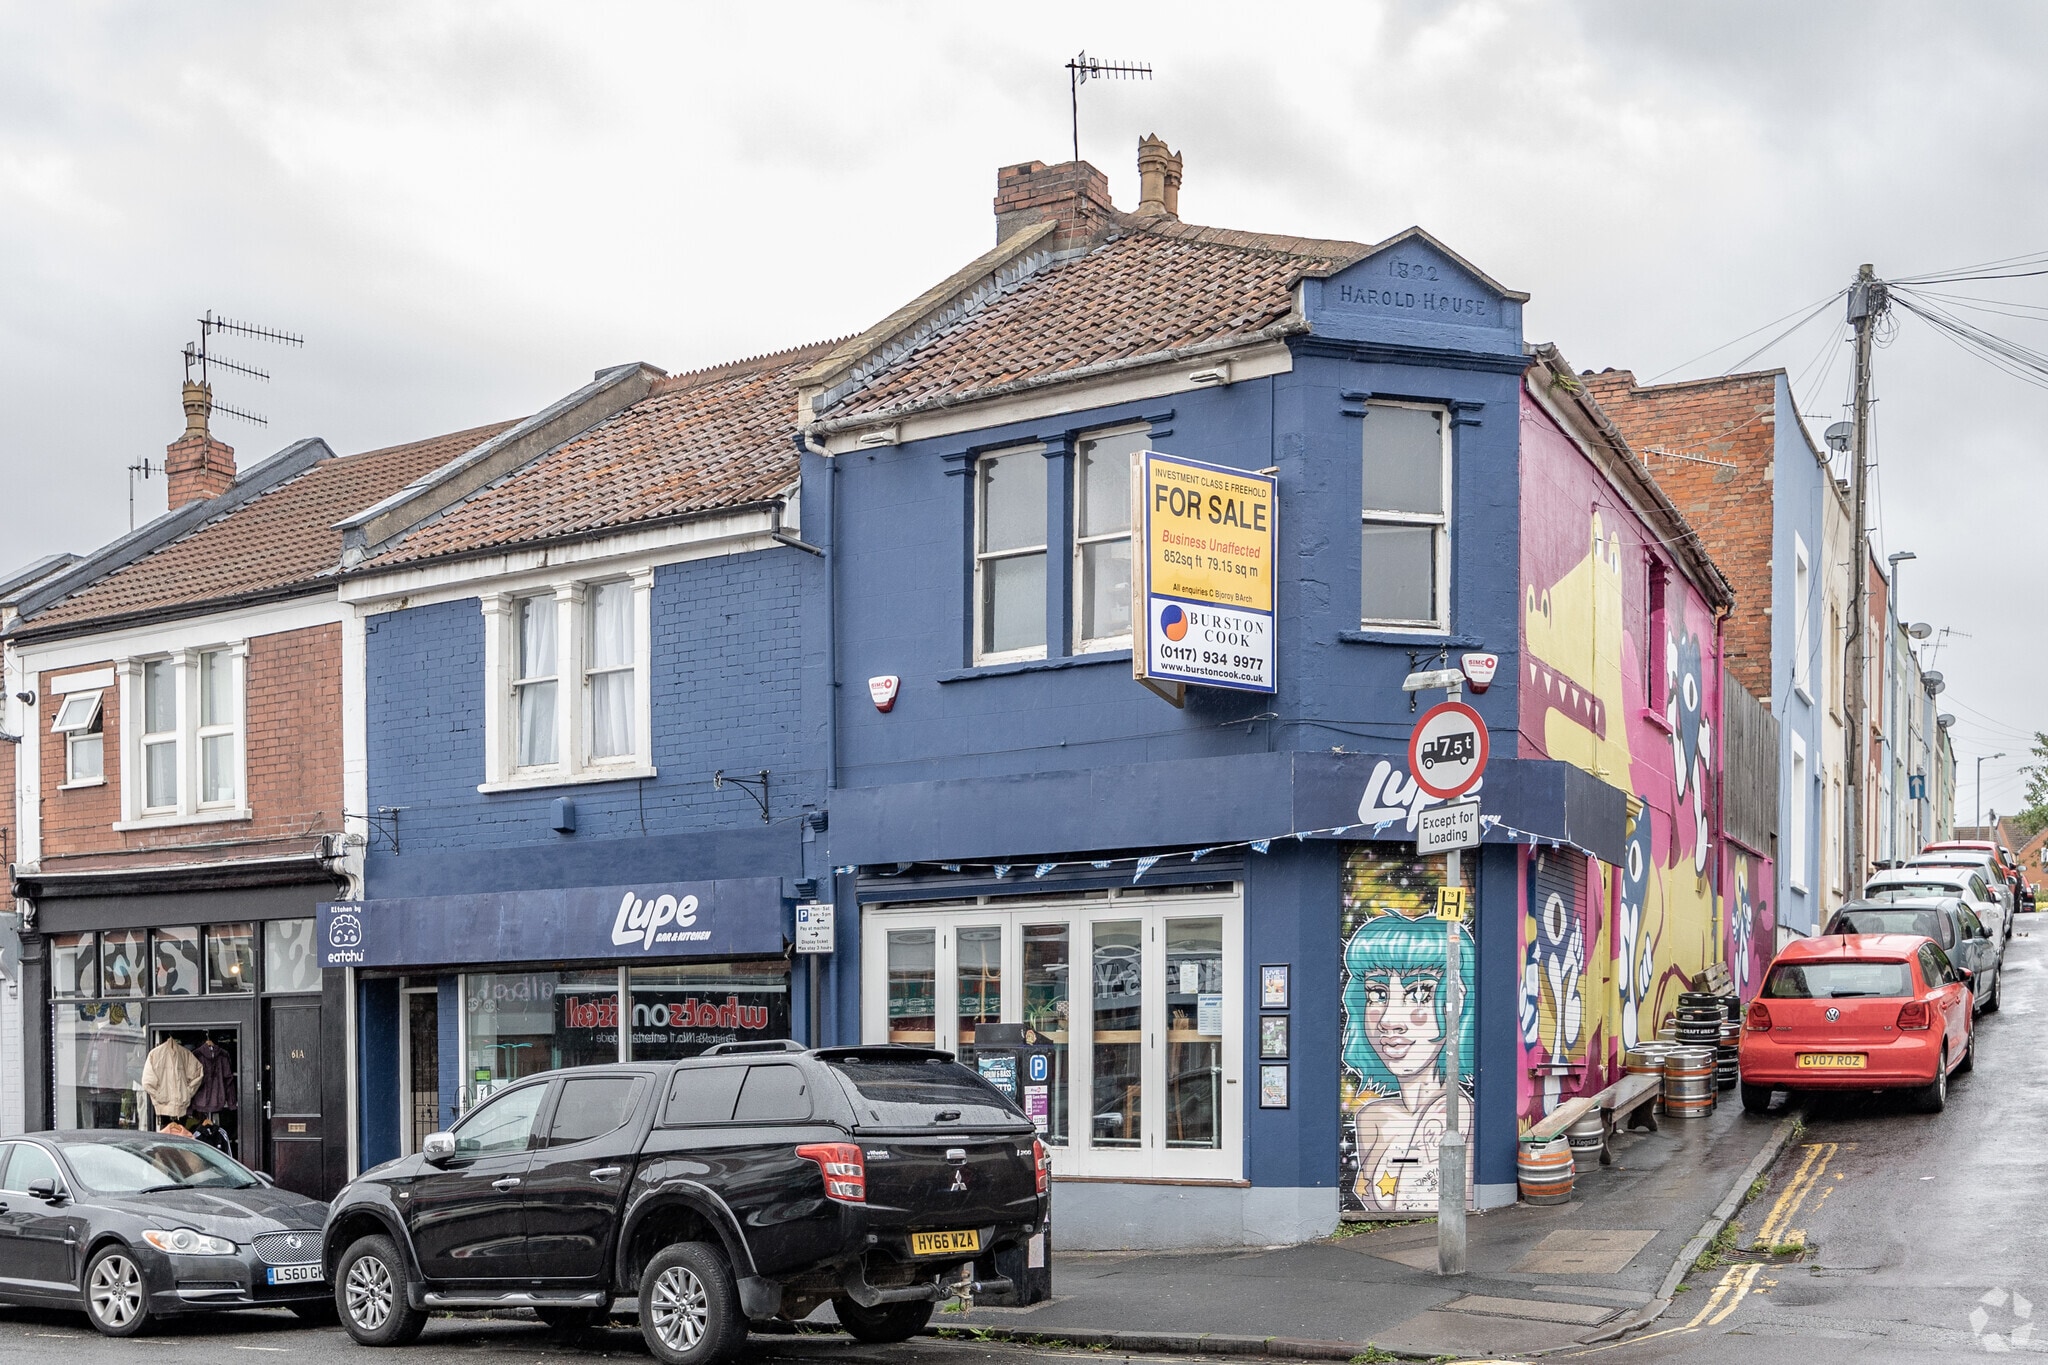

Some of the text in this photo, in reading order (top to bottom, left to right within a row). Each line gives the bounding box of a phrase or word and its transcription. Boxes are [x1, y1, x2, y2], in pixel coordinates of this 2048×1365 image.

[1155, 468, 1266, 498] INVESTMENT CLASS E FREEHOLD
[1155, 484, 1267, 532] FOR SALE
[1162, 529, 1261, 559] Business Unaffected
[1164, 549, 1258, 578] 852sq ft 79.15 sq m
[1173, 583, 1181, 592] All
[1182, 585, 1208, 597] enquiries
[1209, 589, 1214, 597] C
[1190, 612, 1264, 634] BURSTON
[1204, 629, 1250, 648] COOK
[1160, 643, 1264, 670] (0117) 934 9977
[1160, 662, 1264, 683] www.burstoncook.co.uk
[1423, 812, 1456, 830] Except
[1459, 811, 1474, 824] for
[1429, 829, 1468, 845] Loading
[354, 905, 362, 914] by
[611, 891, 699, 951] Lupe
[327, 949, 365, 963] eatchu
[1034, 1059, 1043, 1077] P
[1804, 1055, 1860, 1066] GV07 ROZ
[918, 1233, 974, 1251] HY66 WZA
[276, 1267, 307, 1281] LS60
